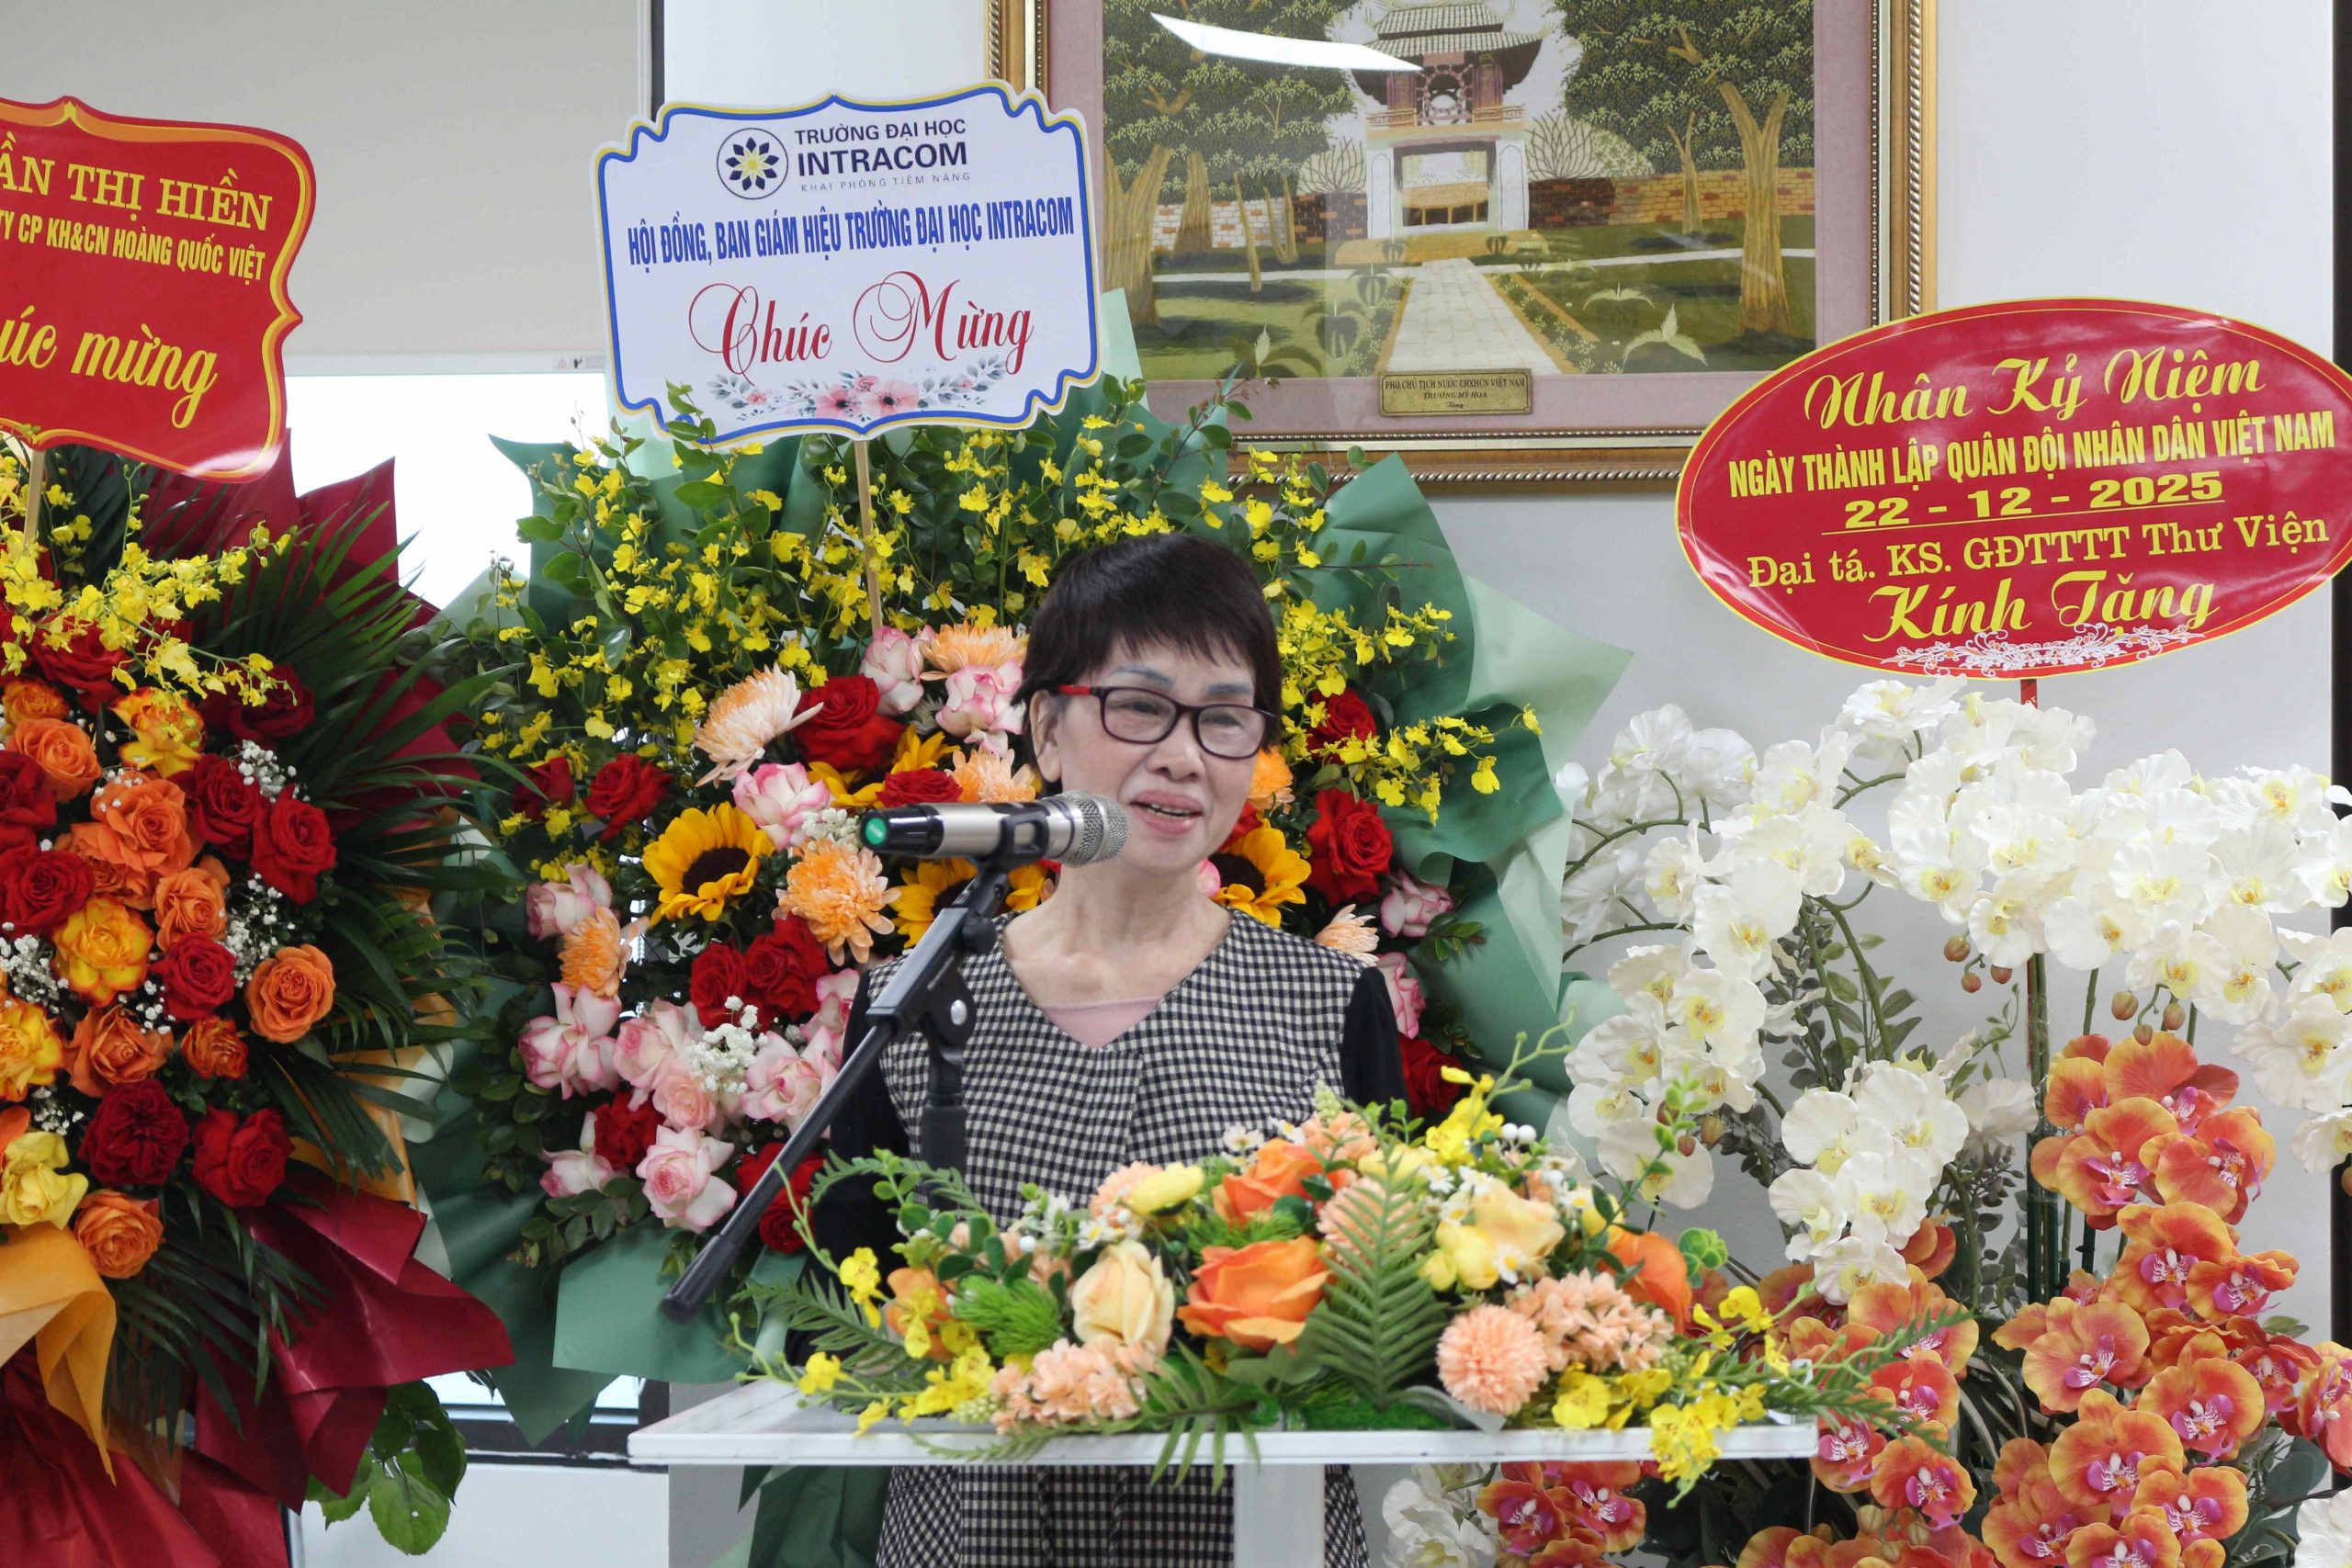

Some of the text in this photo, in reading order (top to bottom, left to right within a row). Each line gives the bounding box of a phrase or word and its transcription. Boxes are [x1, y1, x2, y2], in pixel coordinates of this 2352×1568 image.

[795, 118, 966, 145] TRƯỜNG ĐẠI HỌC
[797, 141, 967, 176] INTRACOM
[67, 163, 145, 221] THỊ
[156, 167, 273, 231] HIỀN
[801, 183, 833, 193] KHAI
[17, 213, 43, 244] CP
[46, 217, 109, 255] KH&CN
[112, 226, 173, 265] HOÀNG
[176, 233, 224, 274] QUỐC
[229, 243, 266, 286] VIỆT
[628, 197, 1074, 273] HỘI ĐỒNG, BAN GIÁM HIỆU TRƯỜNG ĐẠI HỌC INTRACOM
[689, 270, 1035, 387] Chúc Mừng
[71, 323, 219, 429] mừng
[1804, 345, 2267, 430] Nhân Kỷ Niệm
[1729, 410, 2335, 498] NGÀY THÀNH LẬP QUÂN ĐỘI NHÂN DÂN VIỆT NAM
[1845, 470, 2223, 528] 22 - 12 - 2025
[1747, 510, 2330, 594] Đại tá. KS. GĐTTTT Thư Viện
[1862, 570, 2221, 642] Kính Tặng
